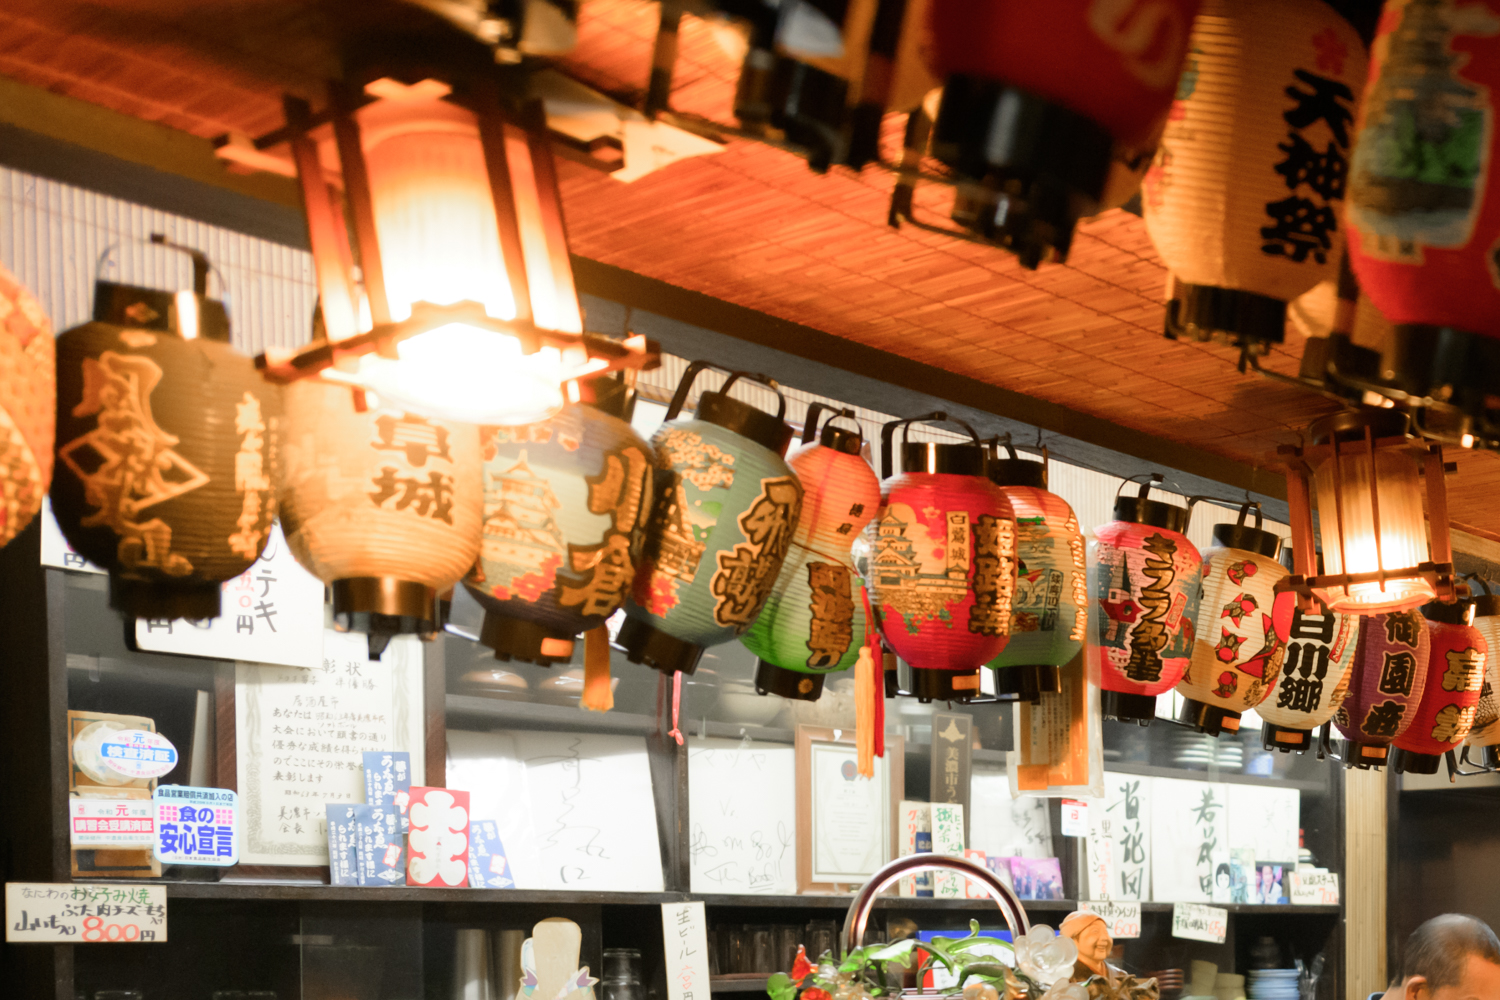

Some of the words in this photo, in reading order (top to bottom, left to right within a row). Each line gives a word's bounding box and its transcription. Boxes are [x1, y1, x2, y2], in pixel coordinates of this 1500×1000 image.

[950, 514, 967, 563] 白鷺城
[1276, 606, 1336, 714] 白川郷
[106, 745, 171, 762] 検査済証
[272, 770, 324, 784] 表彰します
[944, 746, 960, 803] 美濃市う
[157, 788, 234, 802] 食品営業賠償共済加入の店
[75, 819, 154, 832] 講習会受講済証
[178, 805, 215, 824] 食の
[159, 822, 234, 857] 安心宣言
[676, 909, 697, 960] 生ビール
